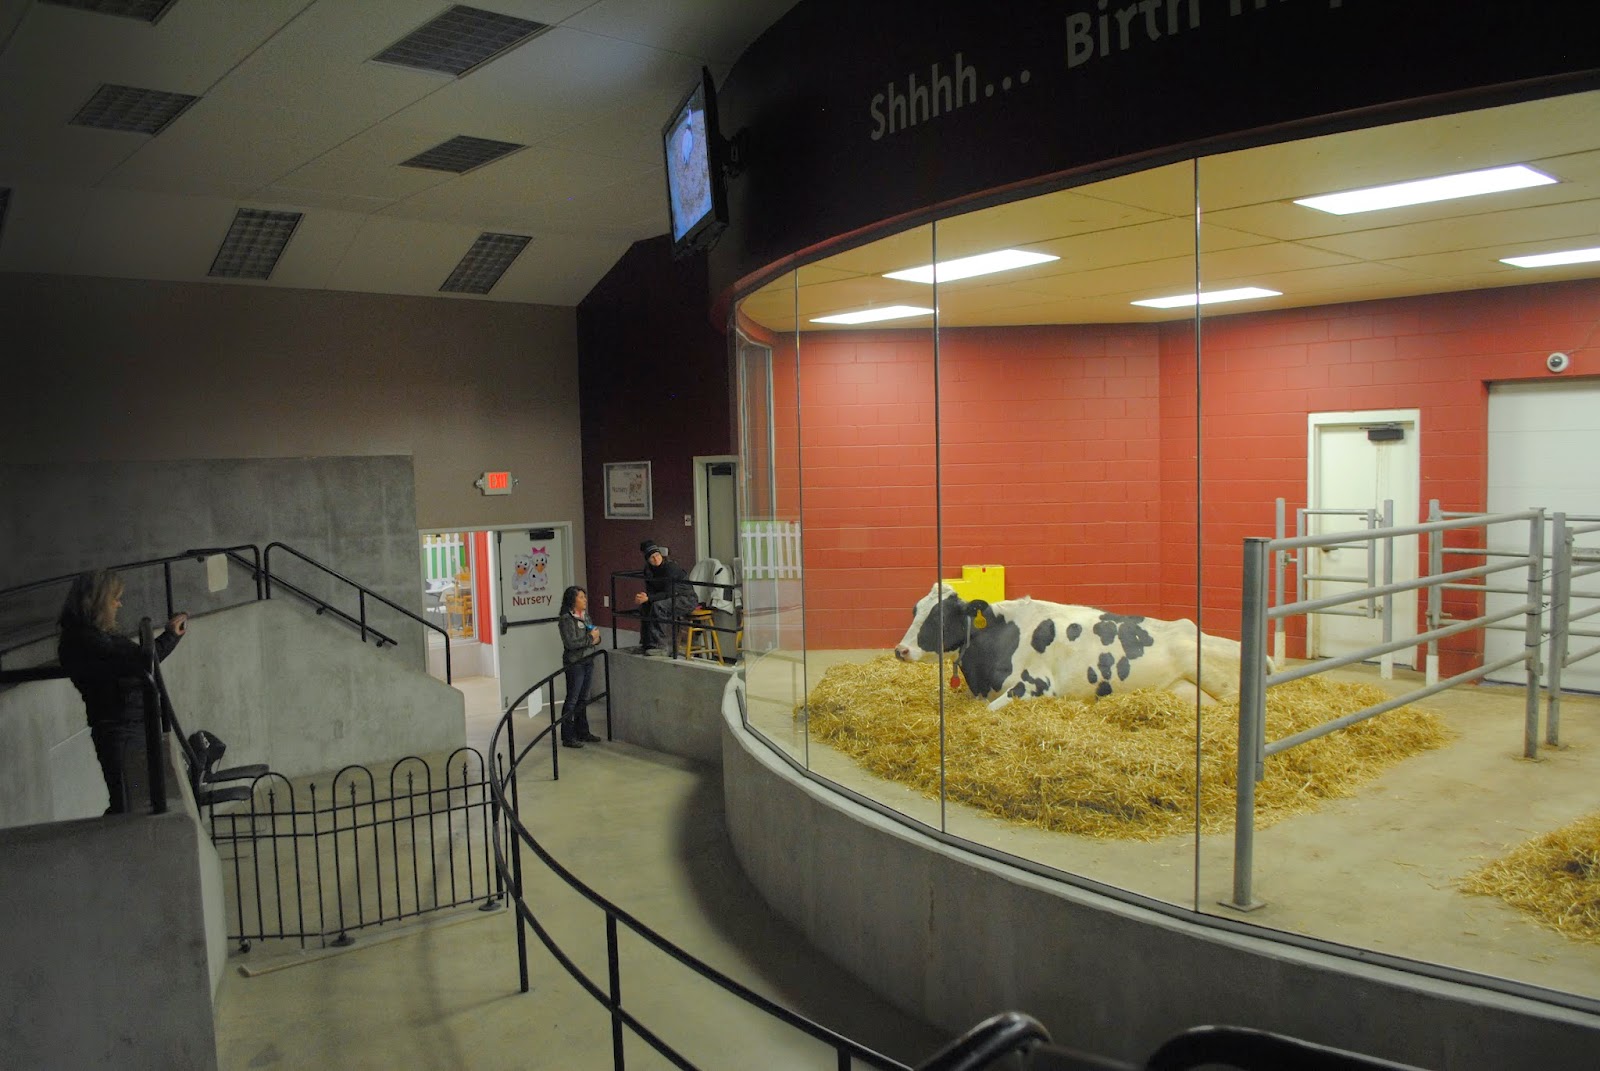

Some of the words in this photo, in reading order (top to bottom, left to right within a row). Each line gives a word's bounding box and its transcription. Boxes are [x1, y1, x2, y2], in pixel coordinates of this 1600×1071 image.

[870, 53, 1031, 141] Shhhh...
[489, 473, 508, 488] EXIT
[512, 595, 552, 607] Nursery
